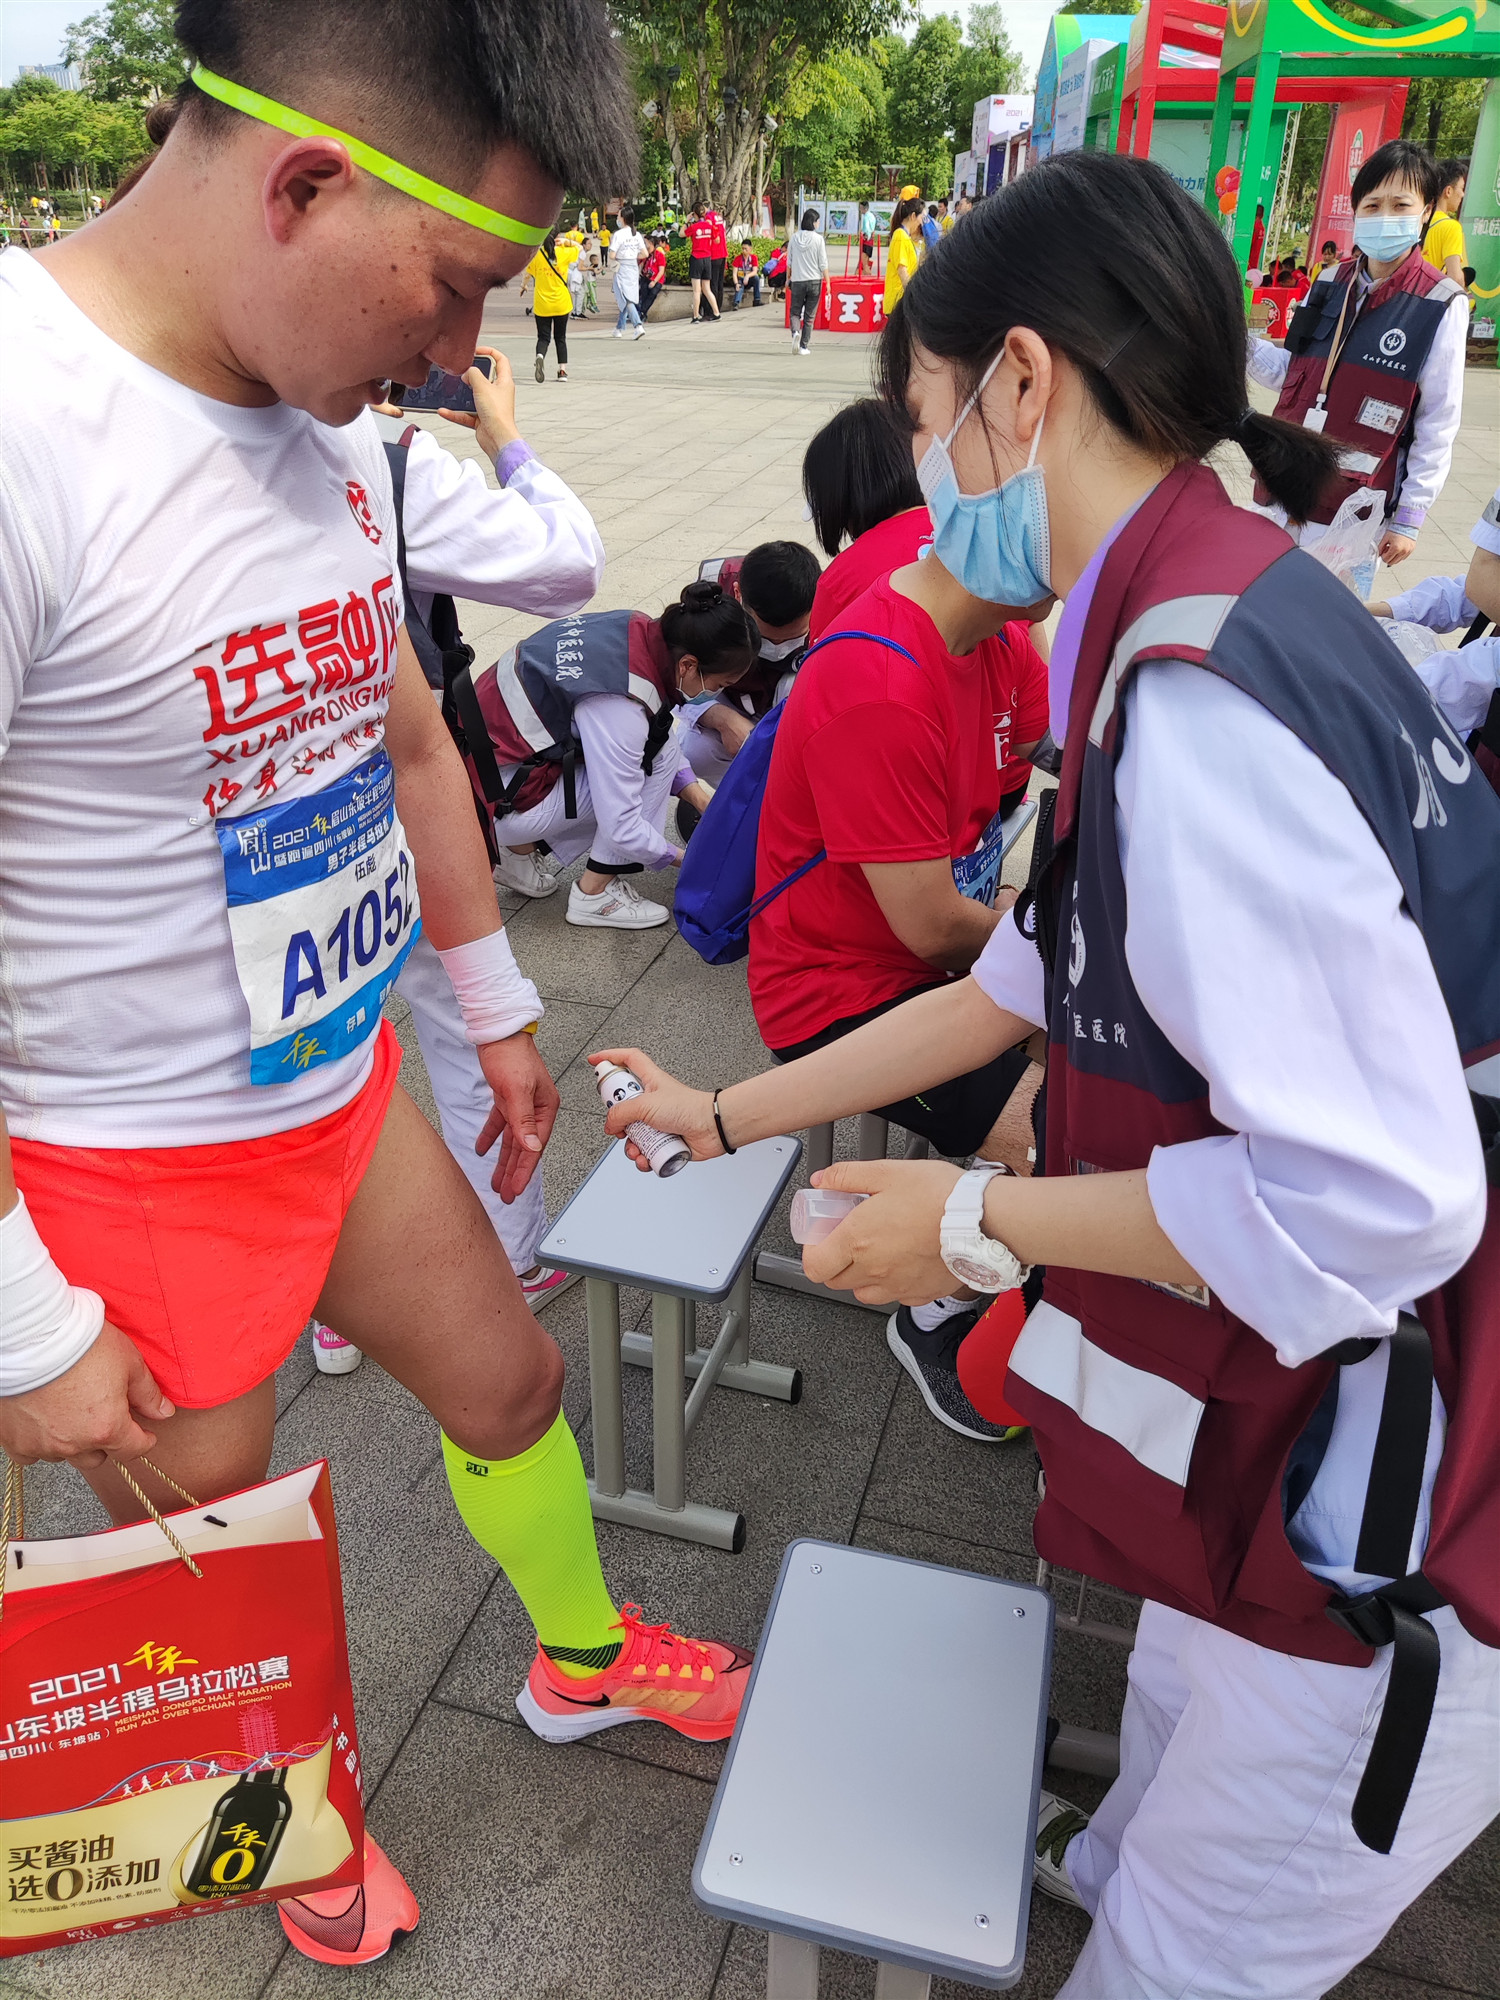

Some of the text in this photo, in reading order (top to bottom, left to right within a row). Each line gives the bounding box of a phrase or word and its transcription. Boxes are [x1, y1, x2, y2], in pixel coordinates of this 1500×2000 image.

[837, 293, 864, 324] 王
[272, 826, 310, 850] 2021
[281, 850, 422, 1020] A1052
[28, 1663, 122, 1705] 2021
[115, 1680, 293, 1727] MEISHAN DONGPO HALF MARATHON
[116, 1695, 273, 1734] RUN ALL OVER SICHUAN (DONGPO)
[8, 1834, 115, 1872] 买酱油
[210, 1848, 256, 1884] 0
[8, 1858, 161, 1902] 选0添加
